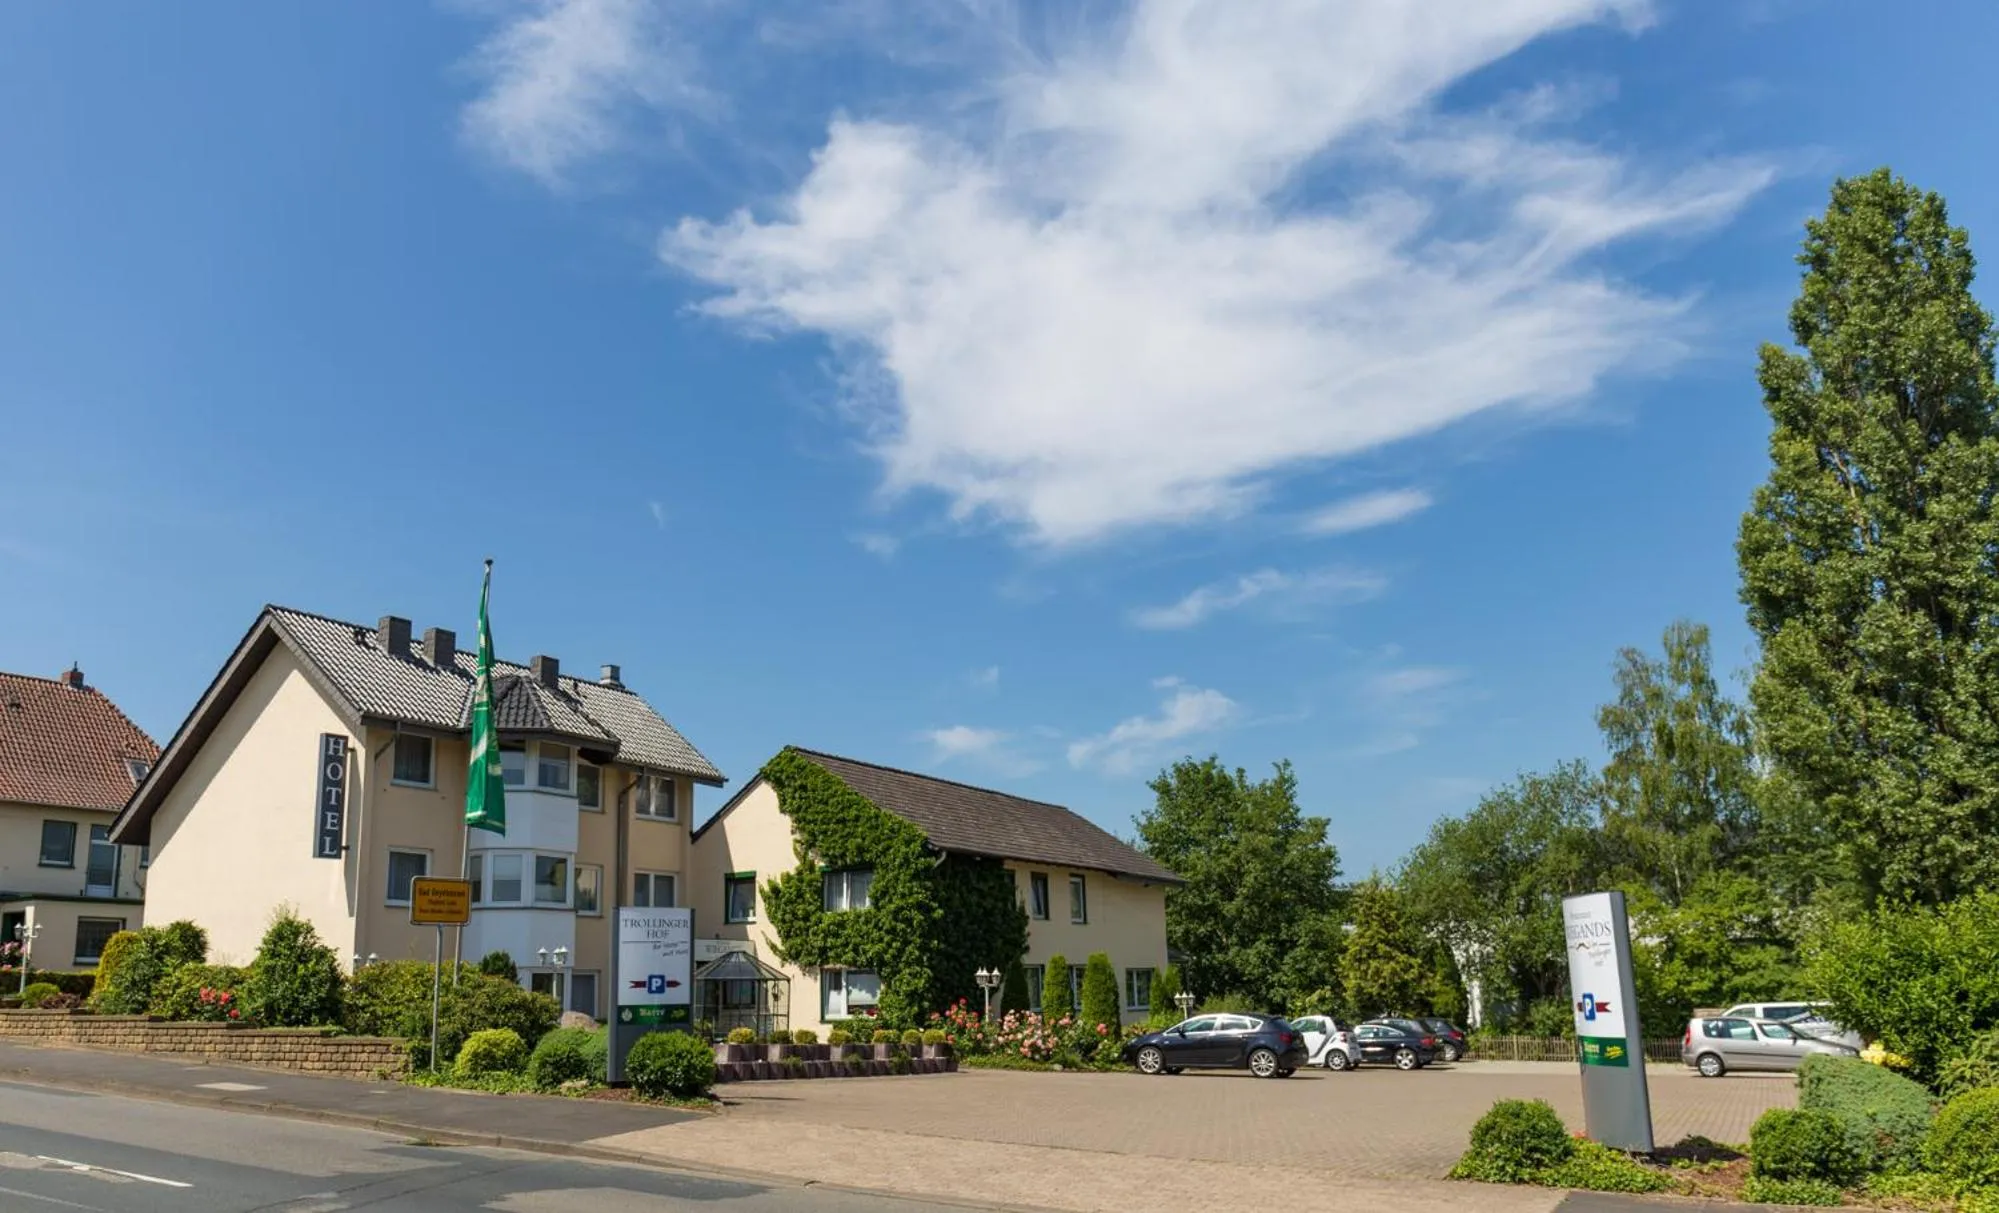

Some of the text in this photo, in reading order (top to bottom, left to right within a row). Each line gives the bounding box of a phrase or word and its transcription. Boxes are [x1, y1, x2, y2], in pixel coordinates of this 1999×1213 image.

[322, 736, 345, 855] HOTEL
[622, 918, 689, 929] TROLLINGER
[645, 929, 670, 939] HOF
